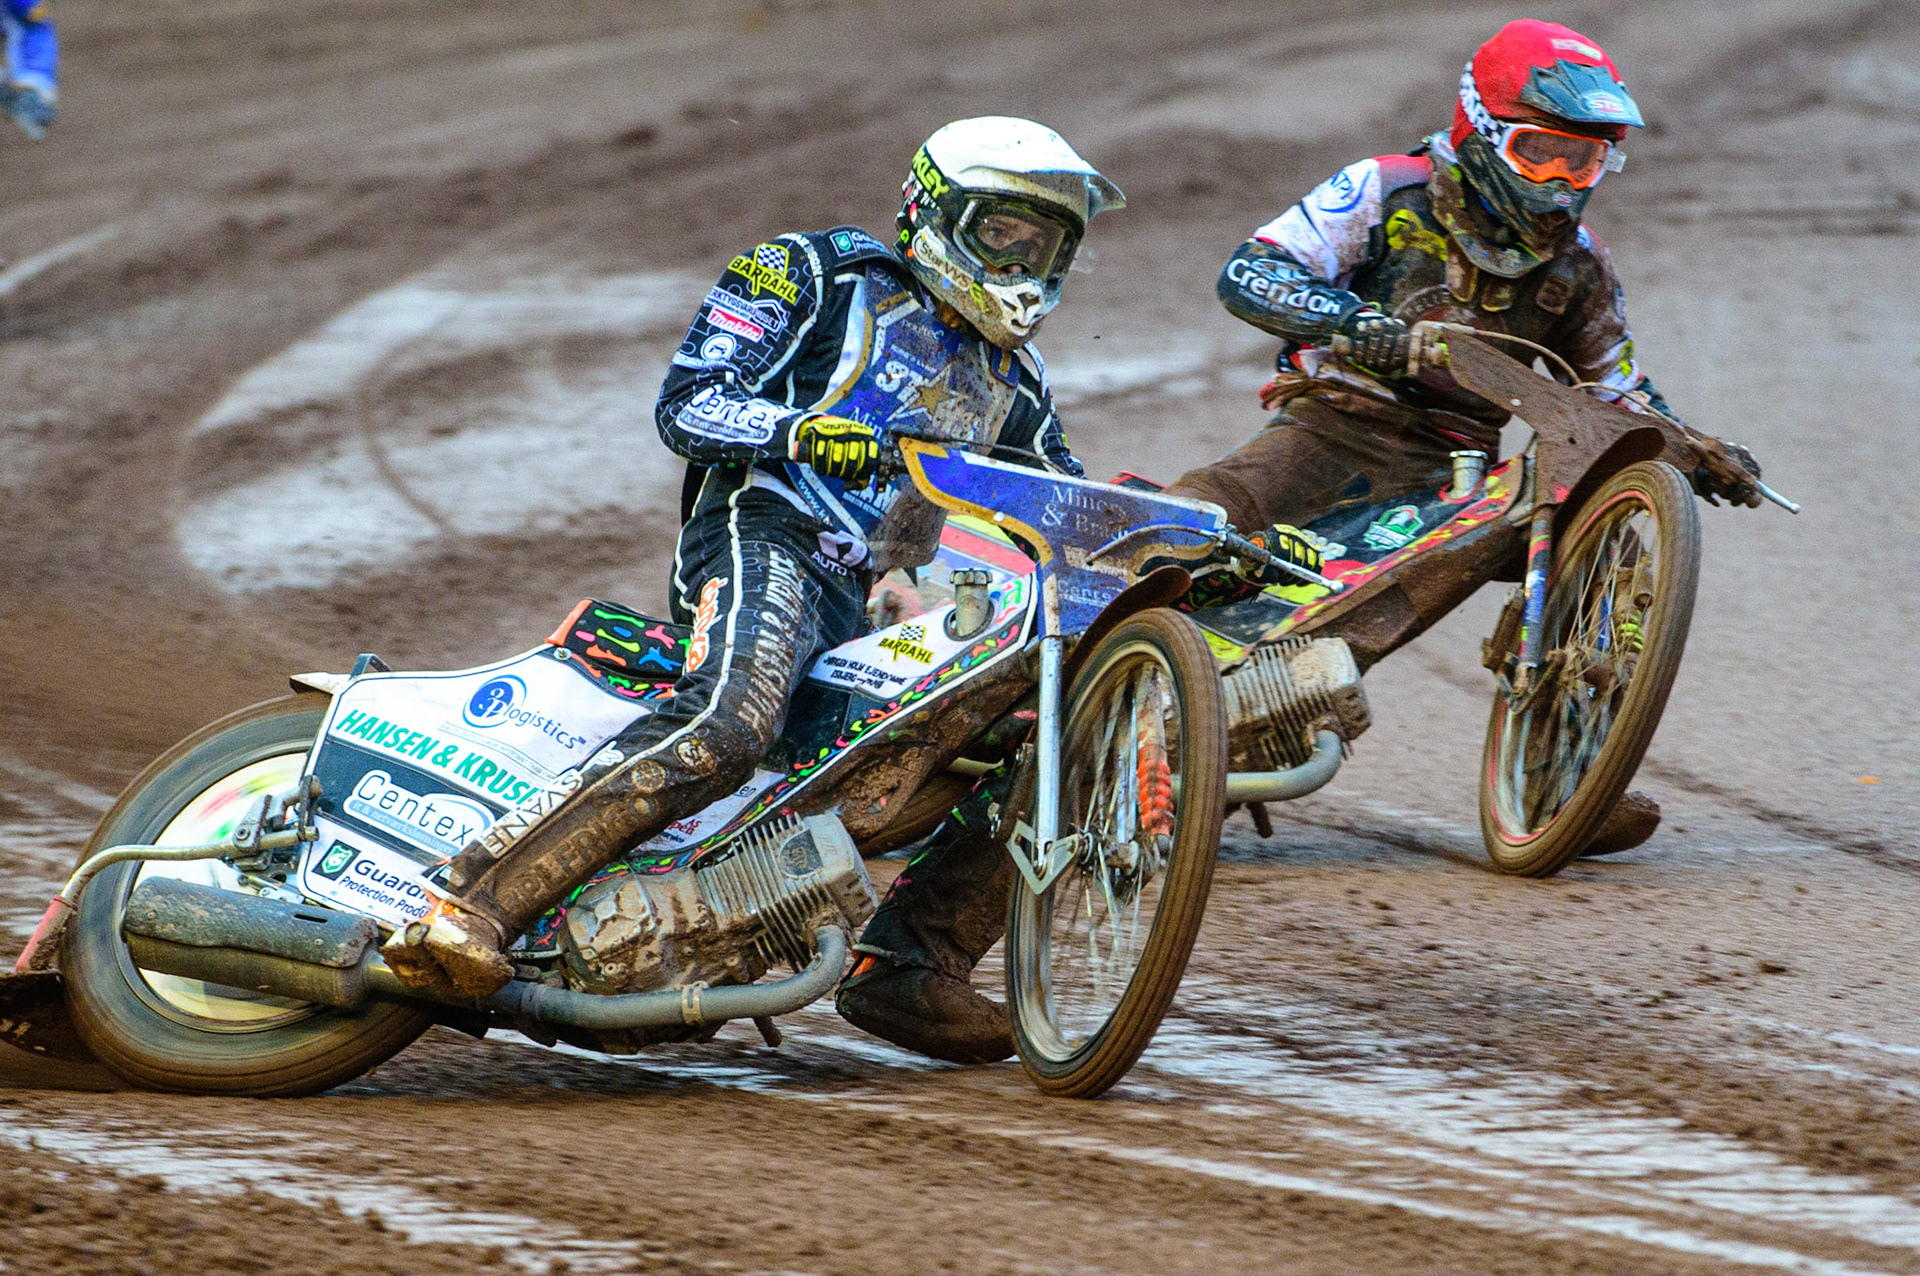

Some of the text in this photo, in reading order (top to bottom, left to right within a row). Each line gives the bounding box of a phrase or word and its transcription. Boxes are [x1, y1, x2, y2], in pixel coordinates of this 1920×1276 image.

[731, 257, 797, 302] BARDAHL
[1041, 502, 1063, 527] &
[811, 550, 848, 577] AUTO
[878, 637, 934, 665] BARDAHL
[336, 709, 440, 760] HANSEN
[431, 744, 459, 768] &
[357, 774, 475, 846] Centex
[338, 875, 430, 919] Protection Produ
